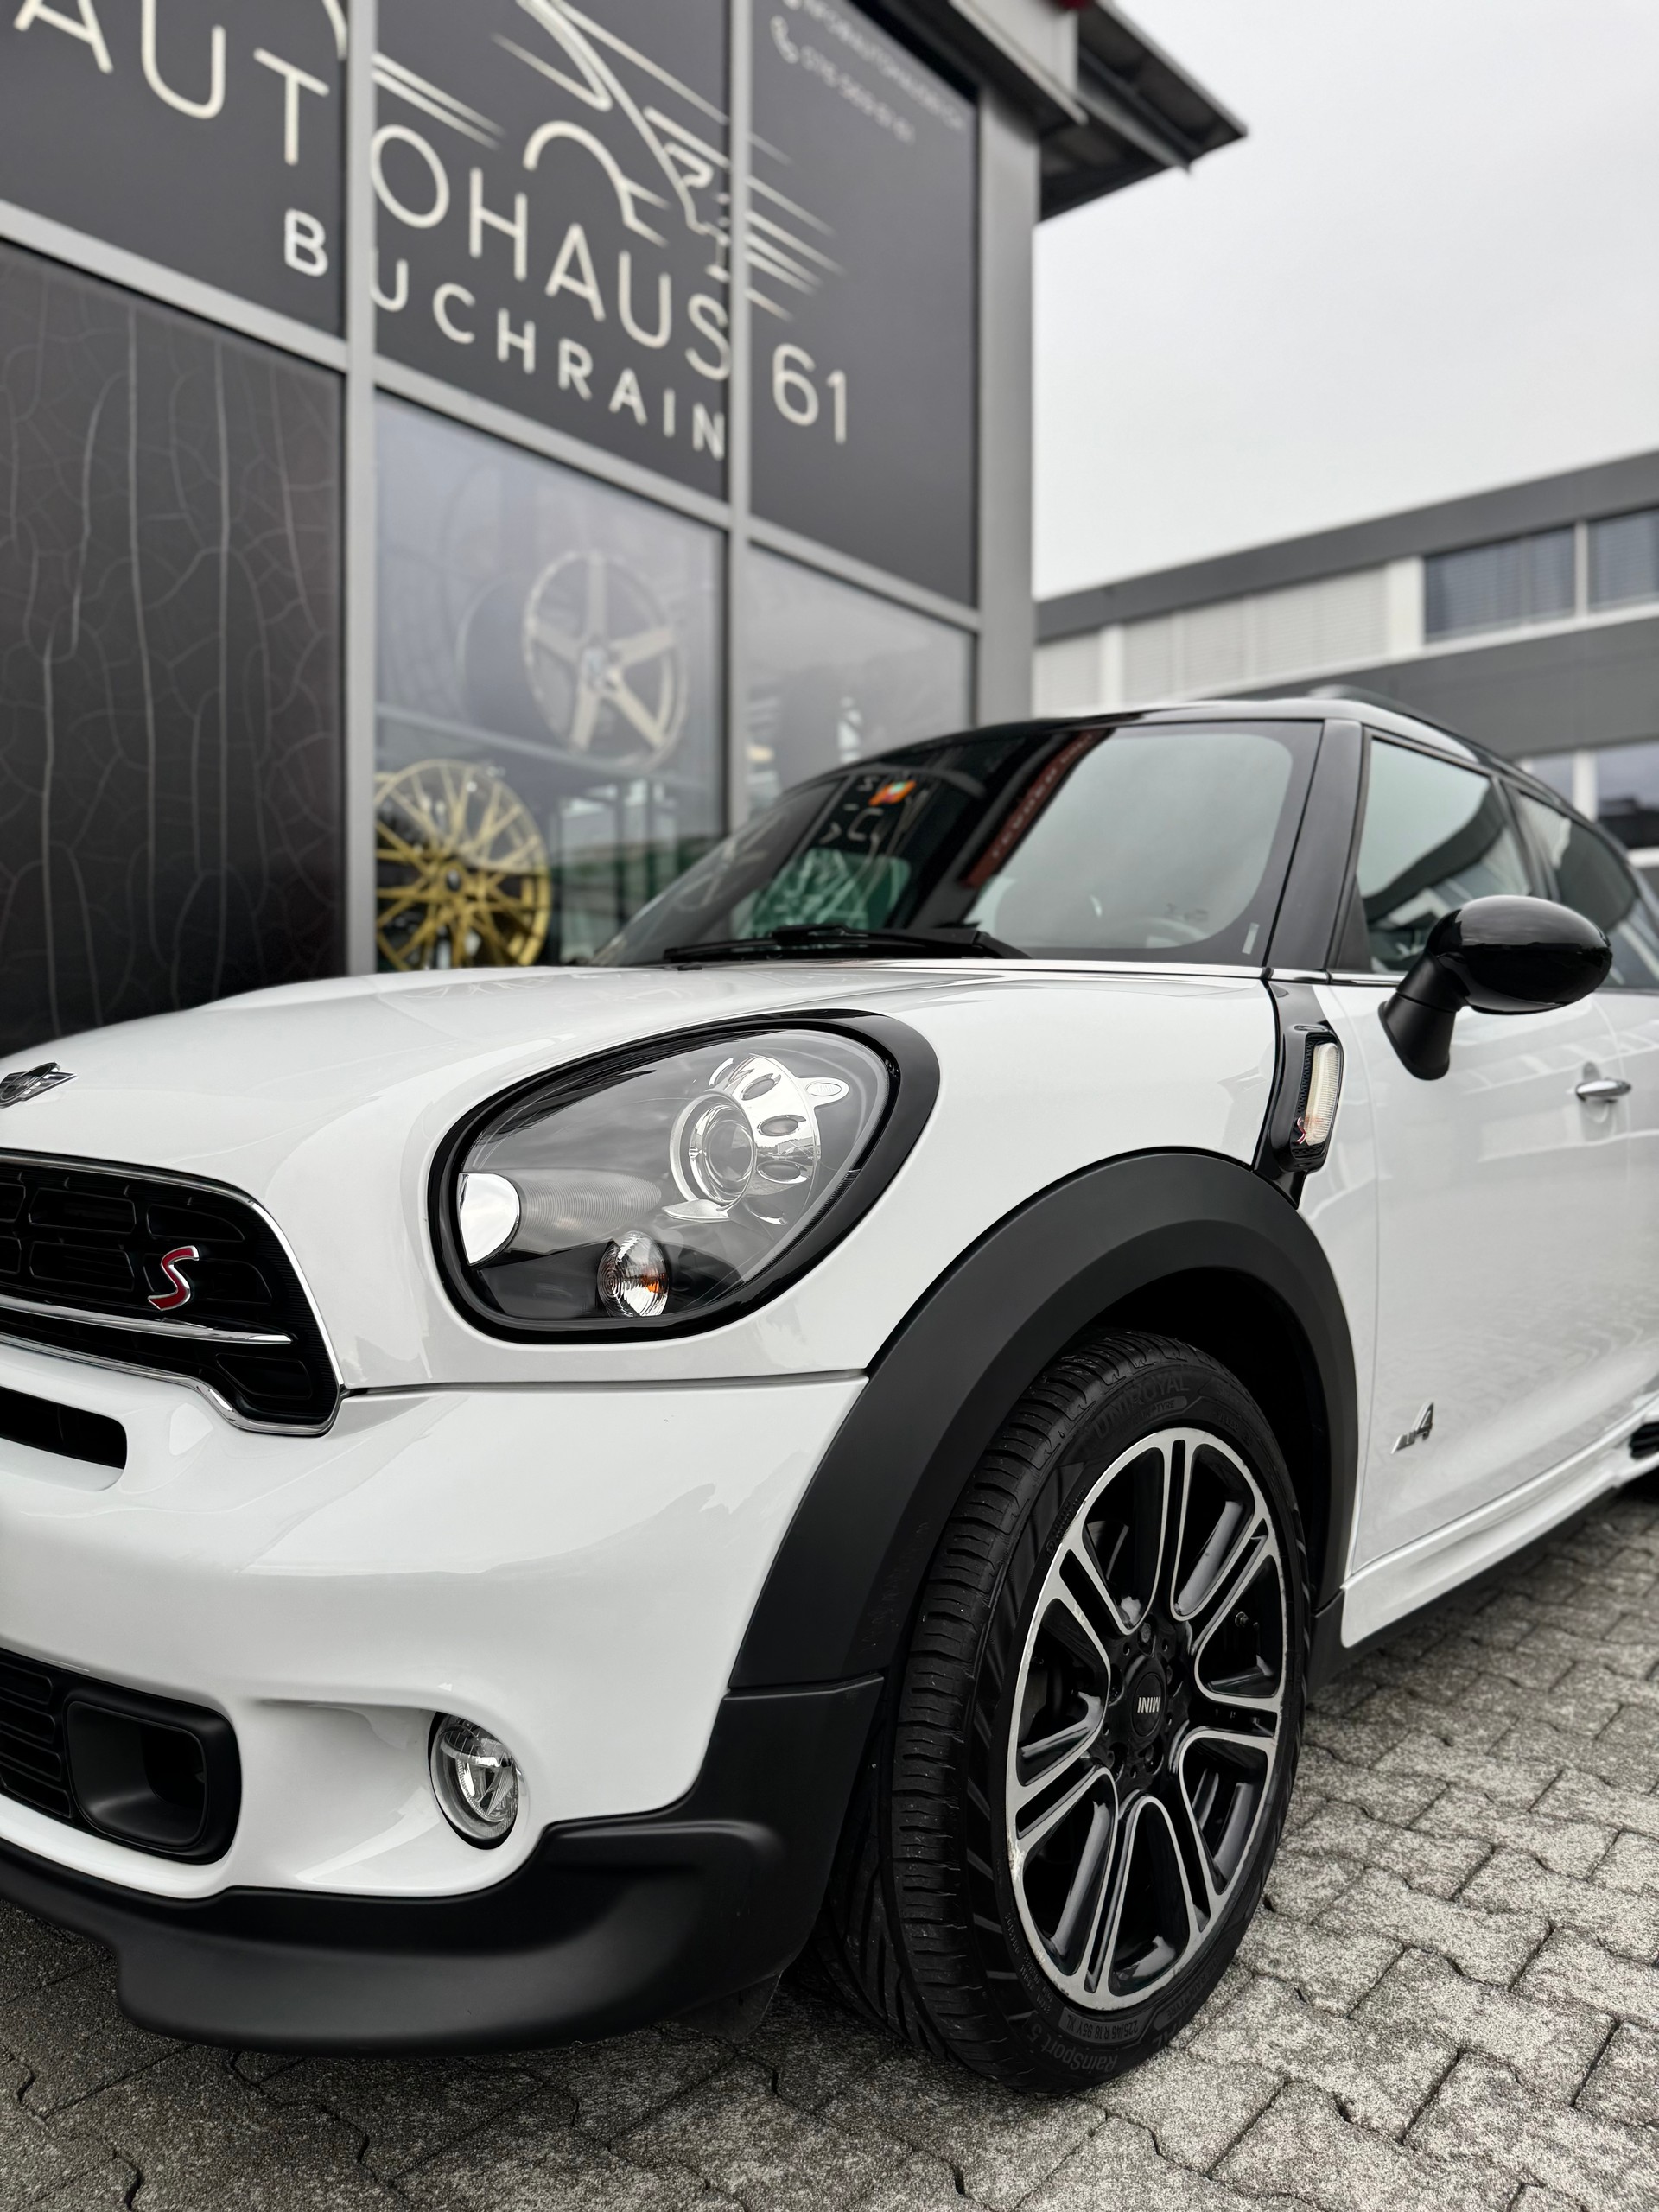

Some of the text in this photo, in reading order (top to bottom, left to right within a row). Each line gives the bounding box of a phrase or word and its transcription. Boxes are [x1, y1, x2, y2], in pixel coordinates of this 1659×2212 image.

[284, 208, 725, 460] BUCHRAIN
[772, 343, 848, 444] 61
[148, 1245, 200, 1311] S
[1136, 1696, 1161, 1713] MINI
[1026, 2023, 1118, 2074] RainSport 5
[1111, 2019, 1139, 2039] 225/45
